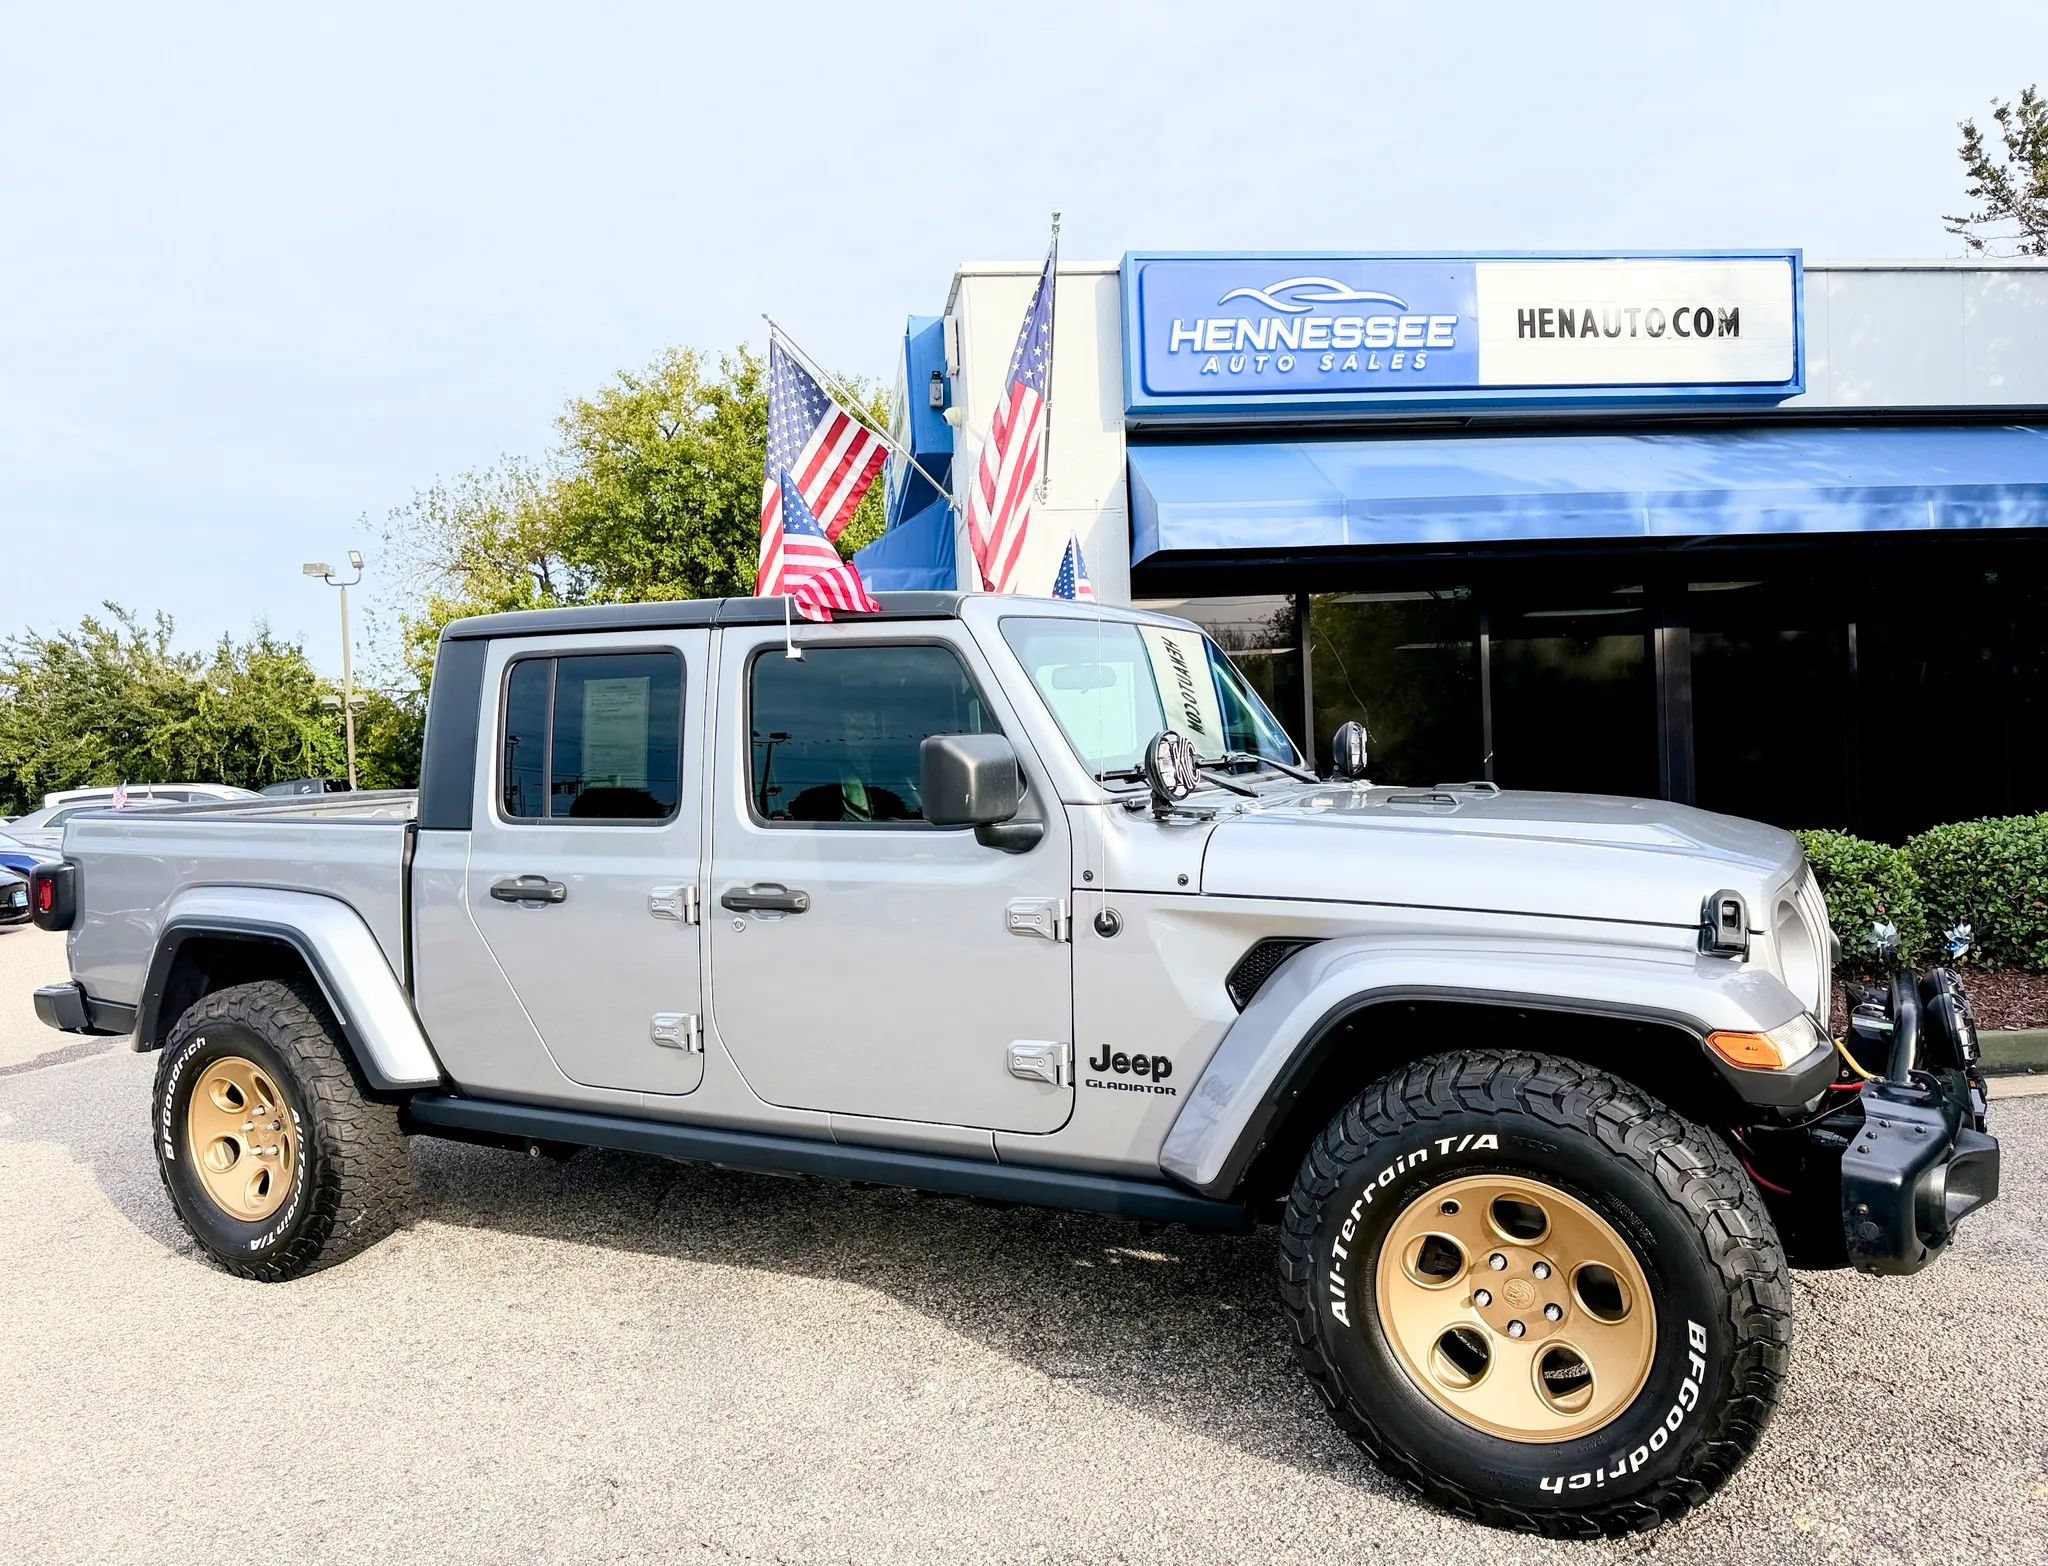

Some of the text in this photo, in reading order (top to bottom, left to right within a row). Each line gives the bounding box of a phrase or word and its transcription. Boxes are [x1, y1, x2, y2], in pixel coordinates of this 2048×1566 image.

[1169, 314, 1459, 352] HENNESSEE
[1201, 350, 1430, 374] AUTO SALES
[162, 1036, 206, 1160] BFGoodrich
[1085, 1079, 1177, 1096] GLADIATOR
[1089, 1043, 1173, 1083] Jeep
[250, 1107, 306, 1251] All-Terrain T/A
[1330, 1134, 1499, 1328] All-Terrain T/A
[1539, 1318, 1707, 1495] BFGoodrich
